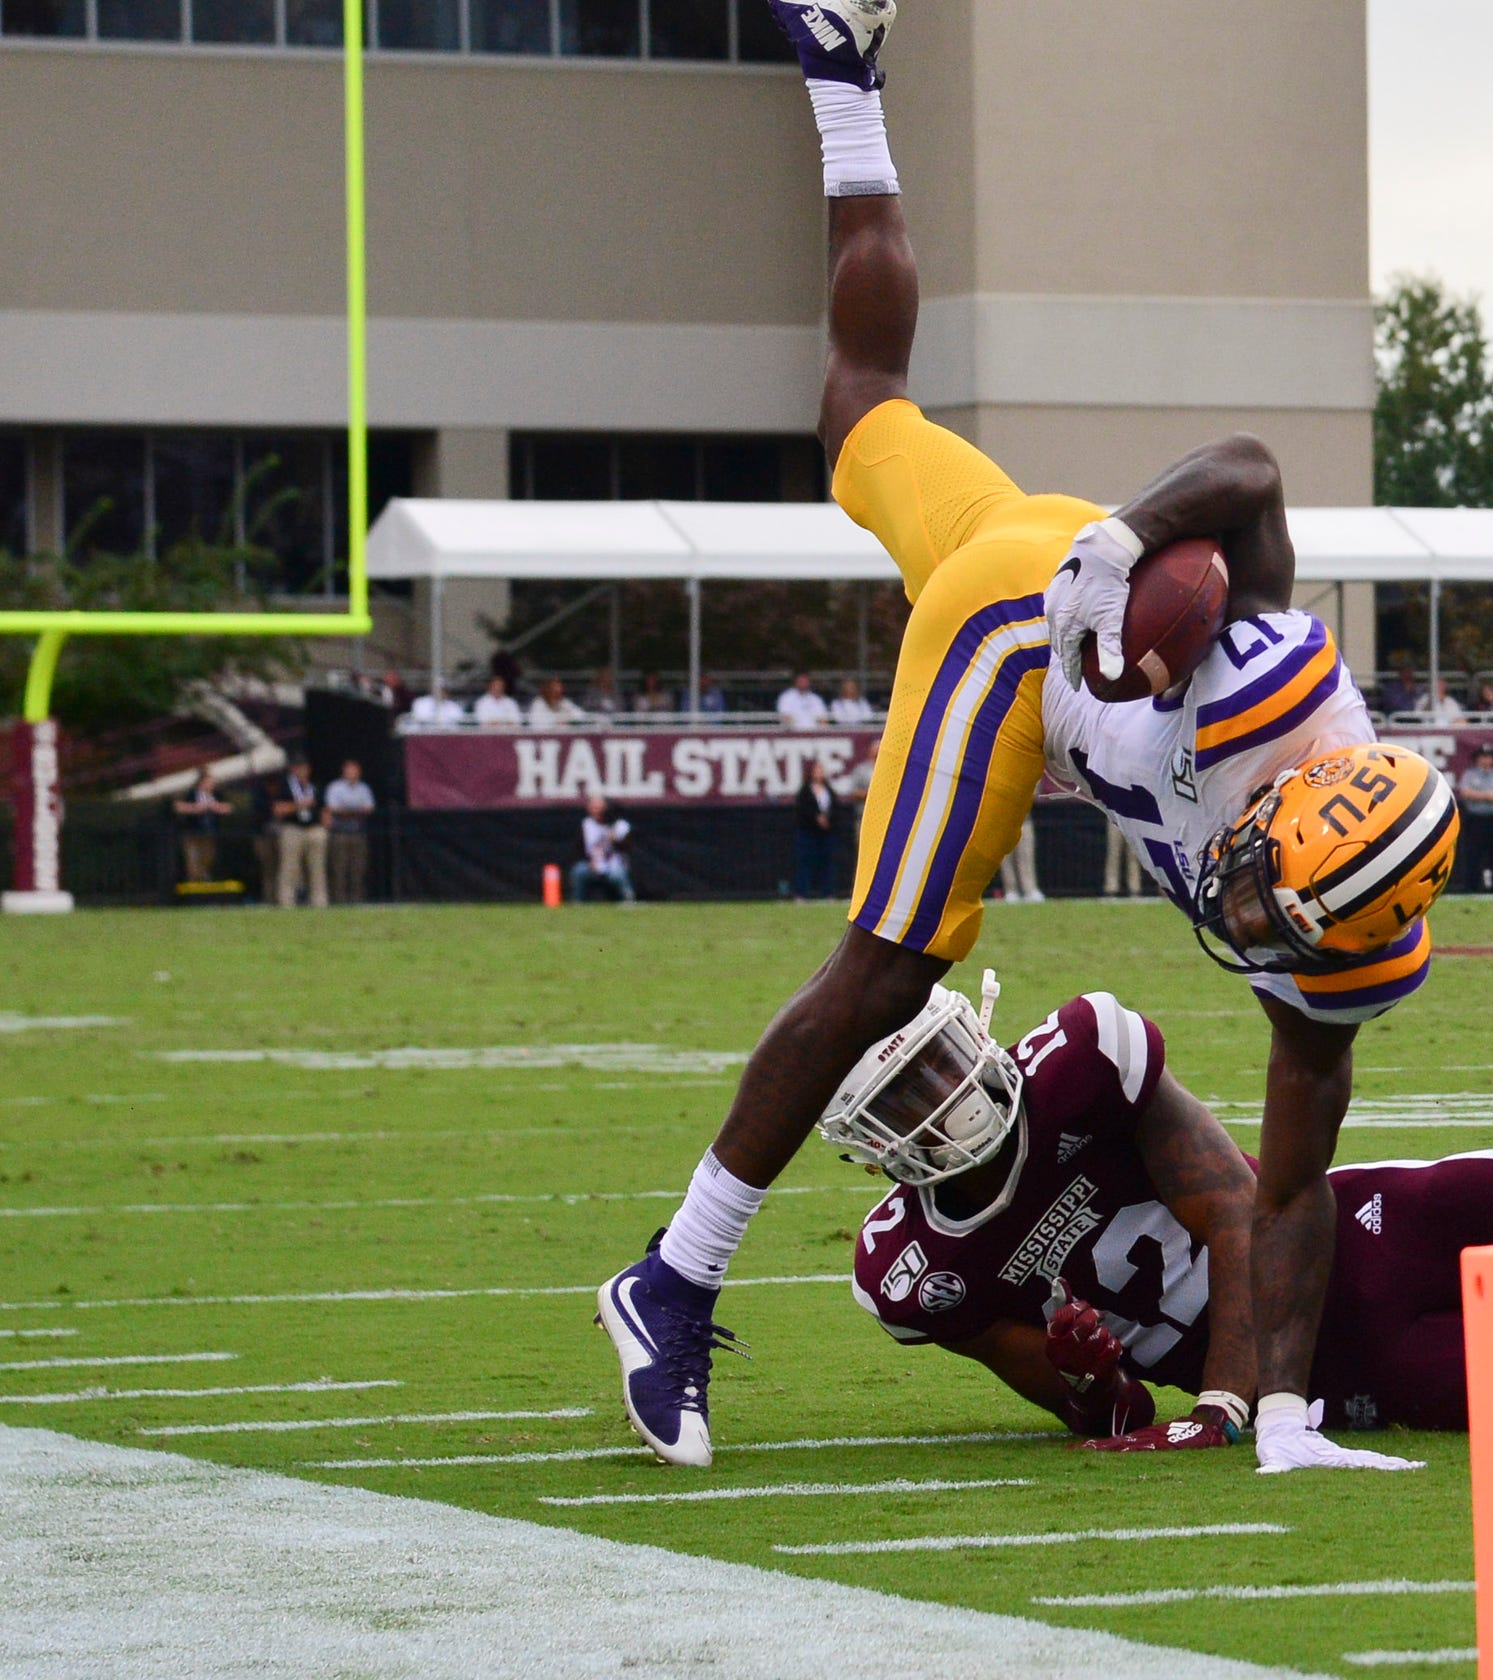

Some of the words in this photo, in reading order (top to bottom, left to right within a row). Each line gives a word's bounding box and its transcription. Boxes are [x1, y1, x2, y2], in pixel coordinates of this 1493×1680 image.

[801, 3, 847, 52] NIKE
[514, 739, 665, 799] HAIL
[672, 738, 855, 798] STATE
[1173, 840, 1195, 881] LSU
[877, 1032, 906, 1062] STATE
[1017, 1009, 1068, 1077] 12
[1002, 1176, 1096, 1287] MISSISSIPPI
[1372, 1193, 1382, 1235] adidas
[1048, 1212, 1090, 1273] STATE
[880, 1240, 928, 1302] 150
[921, 1273, 963, 1310] SEC
